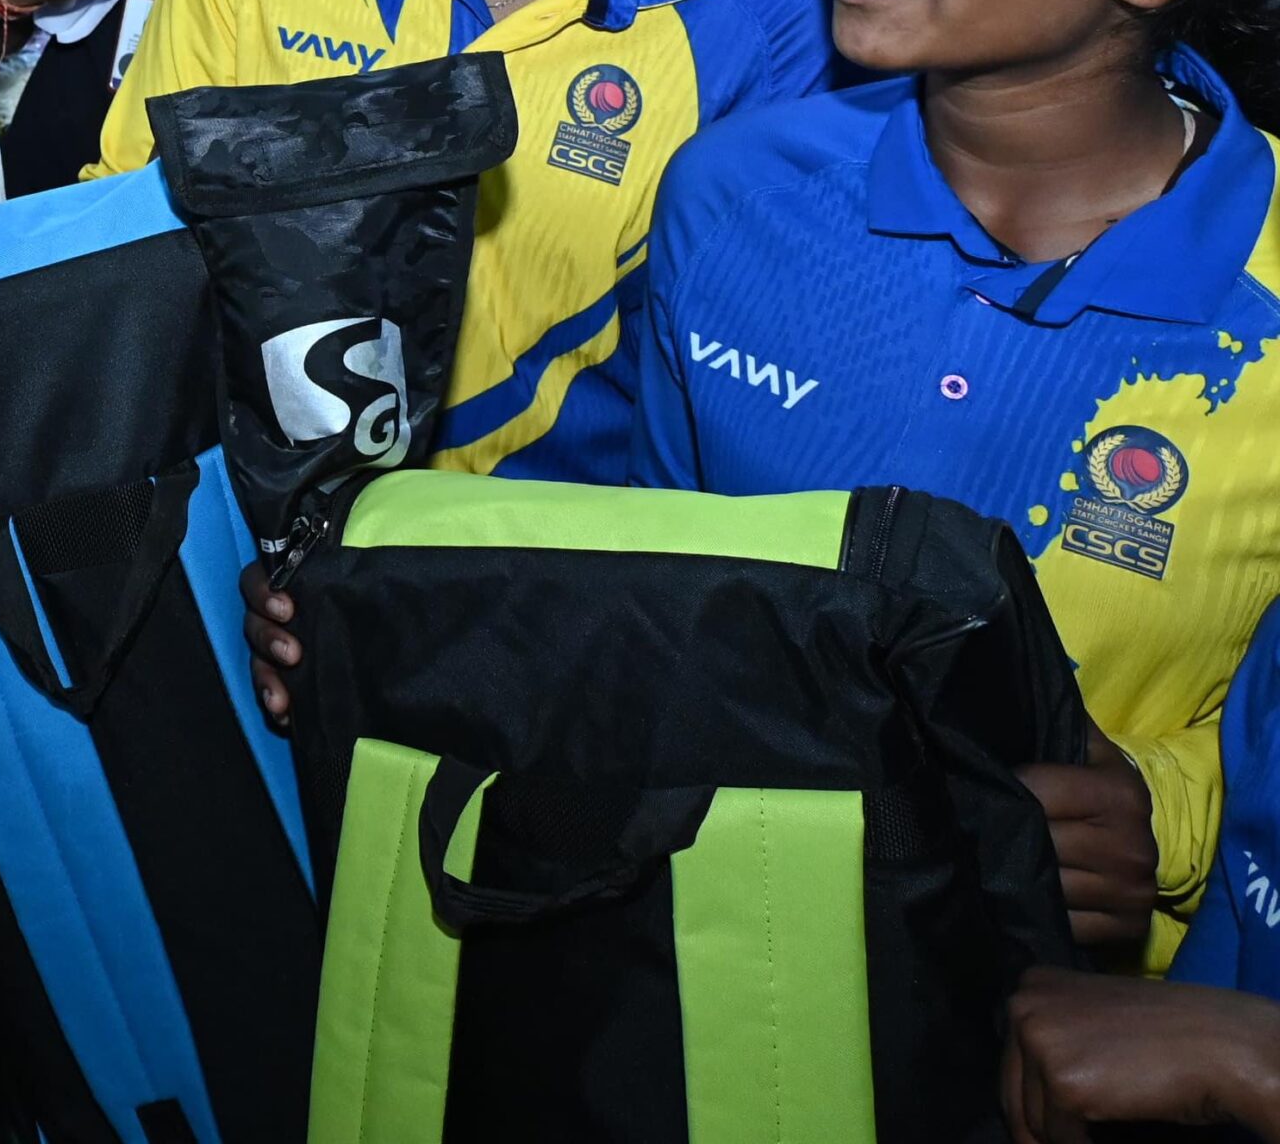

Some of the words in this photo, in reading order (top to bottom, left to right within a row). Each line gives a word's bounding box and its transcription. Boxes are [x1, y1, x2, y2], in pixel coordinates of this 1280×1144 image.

[551, 144, 623, 179] CSCS
[1072, 508, 1095, 521] STATE
[1098, 516, 1136, 533] CRICKET
[1138, 528, 1169, 545] SANGH
[1074, 497, 1171, 535] CHHATTISGARH
[1065, 524, 1165, 572] CSCS
